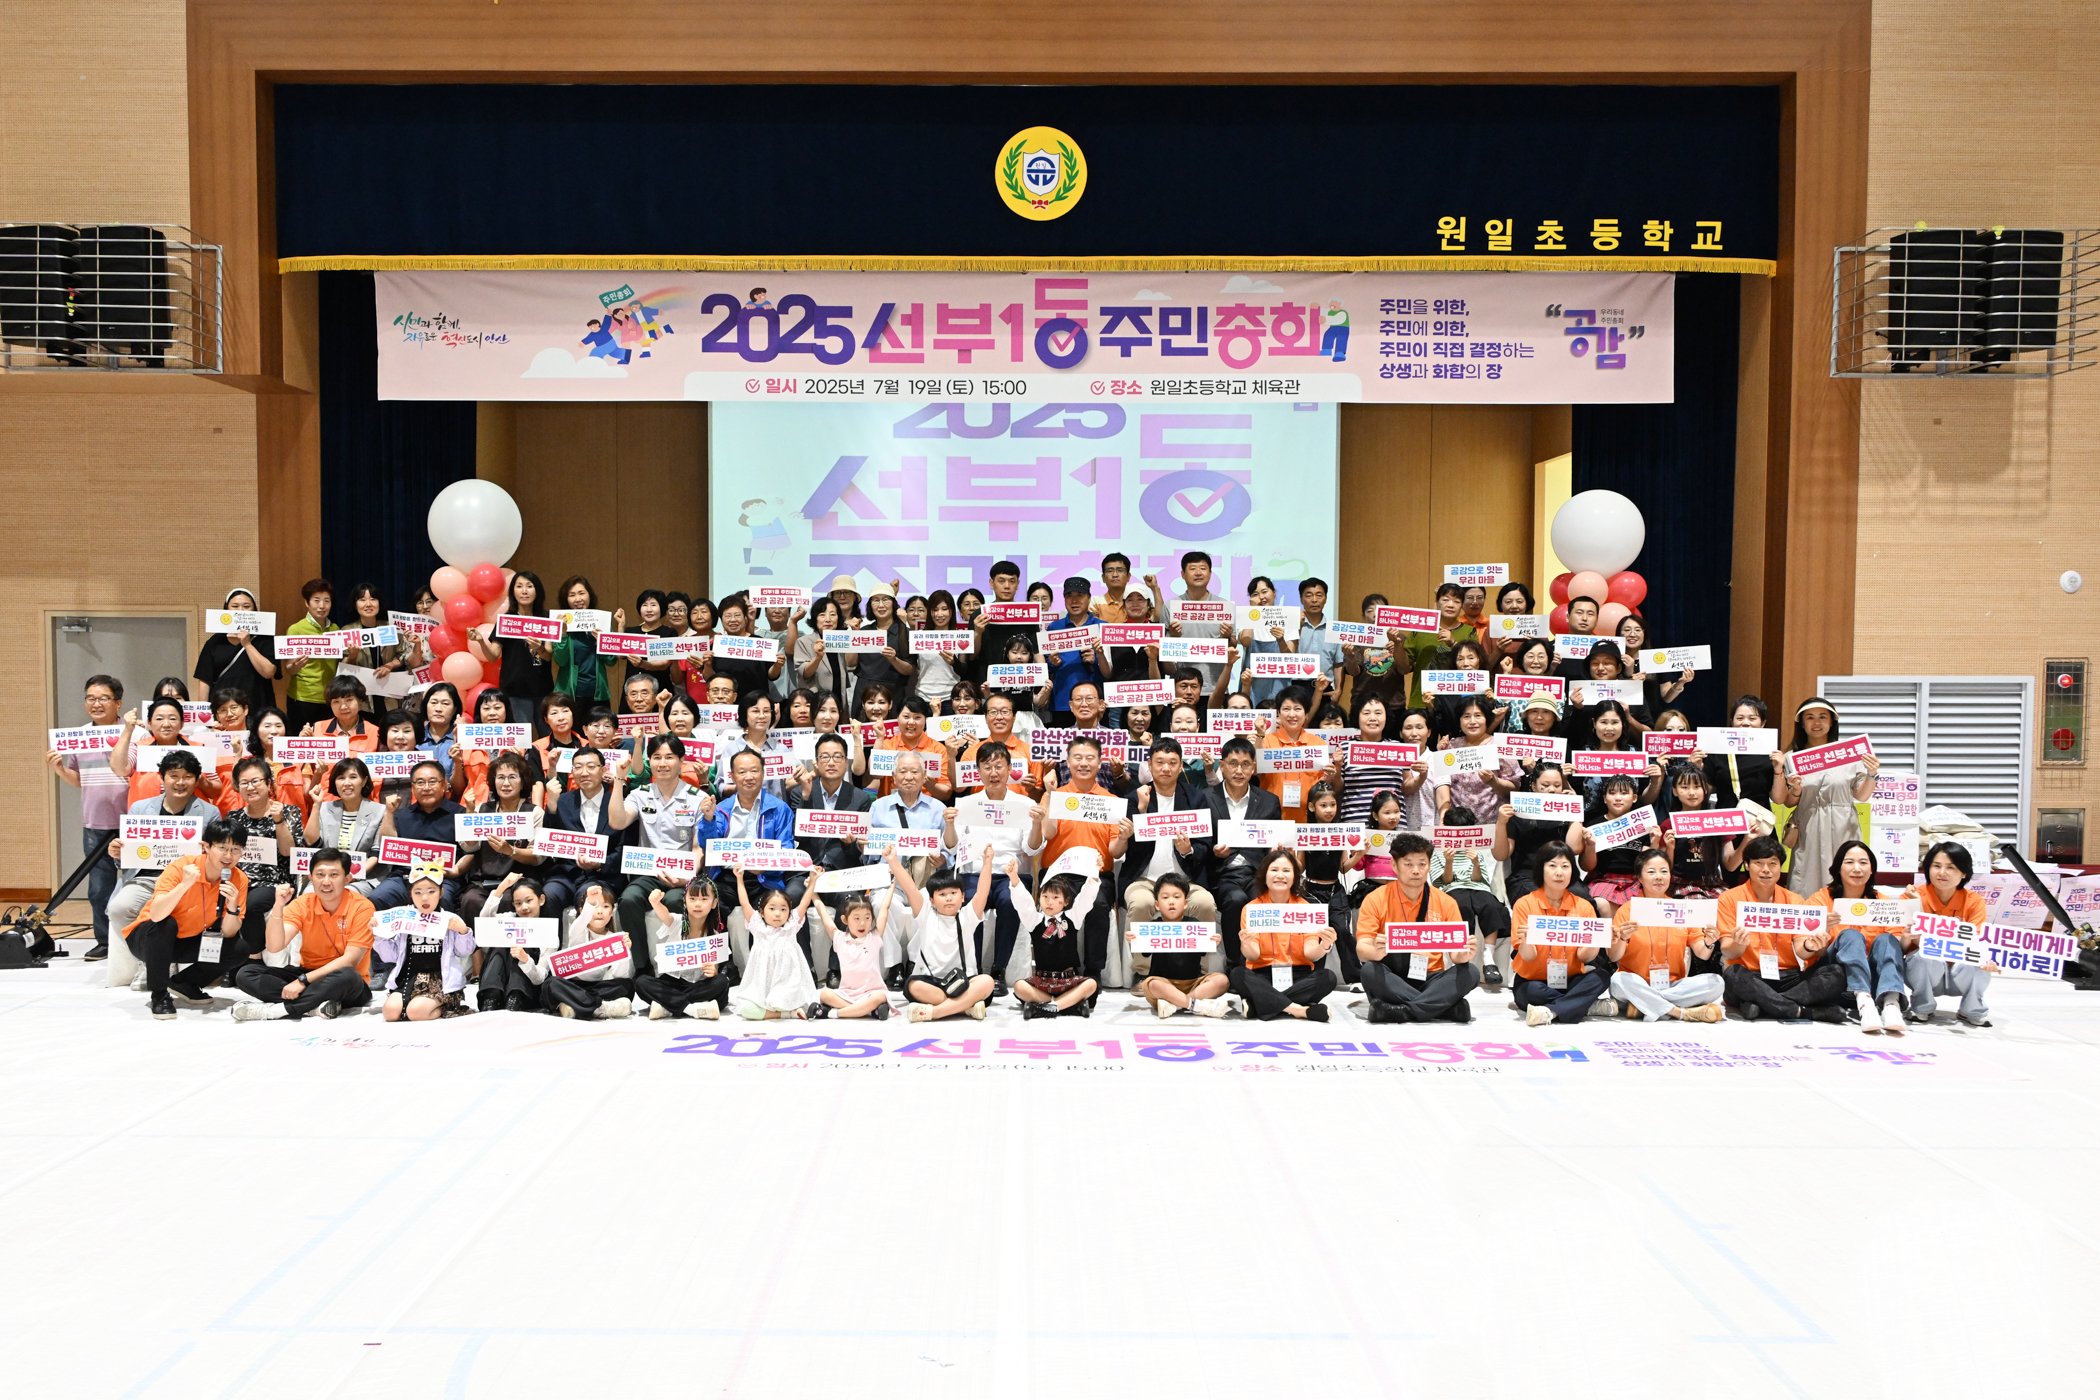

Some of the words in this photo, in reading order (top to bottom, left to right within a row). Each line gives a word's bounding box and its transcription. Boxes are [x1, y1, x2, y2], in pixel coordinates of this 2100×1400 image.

[603, 289, 632, 304] 주민총회
[1380, 298, 1428, 314] 주민을
[1432, 298, 1470, 316] 위한,
[701, 292, 857, 366] 2025
[862, 277, 1089, 370] 선부1동
[1099, 303, 1321, 370] 주민총회
[1380, 320, 1428, 337] 주민에
[1432, 320, 1470, 339] 의한,
[441, 331, 482, 349] 혁신도시
[485, 332, 510, 344] 안산
[1380, 341, 1428, 357] 주민이
[1432, 341, 1465, 357] 직접
[1470, 341, 1534, 357] 결정하는
[1380, 363, 1428, 379] 상생과
[1432, 363, 1482, 380] 화합의
[1486, 363, 1501, 380] 장
[766, 378, 797, 393] 일시
[805, 379, 864, 395] 2025년
[874, 379, 900, 395] 7월
[908, 379, 942, 395] 19일
[947, 378, 974, 397] (토)
[983, 380, 1027, 395] 15:00
[1110, 379, 1142, 396] 장소
[1151, 379, 1247, 397] 원일초등학교
[1251, 378, 1300, 397] 체육관
[802, 413, 1252, 542] 선부1동
[1451, 566, 1483, 575] 공감으로
[1487, 566, 1502, 574] 잇는
[1459, 576, 1475, 584] 우리
[1478, 575, 1495, 584] 마을
[1006, 607, 1037, 619] 선부1동
[1400, 614, 1436, 626] 선부1동
[523, 623, 558, 636] 선부1동
[1126, 629, 1162, 640] 선부1동
[1332, 623, 1364, 632] 공감으로
[1367, 626, 1383, 635] 잇는
[378, 627, 396, 645] 길
[852, 637, 885, 646] 선부1동
[1339, 634, 1355, 642] 우리
[1358, 635, 1374, 644] 마을
[675, 641, 708, 652] 선부1동
[720, 637, 753, 647] 공감으로
[757, 640, 772, 649] 잇는
[915, 640, 956, 651] 선부1동!
[728, 647, 743, 656] 우리
[747, 649, 763, 658] 마을
[1190, 644, 1225, 655] 선부1동
[1027, 666, 1042, 674] 잇는
[1256, 664, 1301, 674] 선부1동!
[1019, 676, 1034, 684] 마을
[1428, 673, 1464, 681] 공감으로
[1467, 673, 1484, 681] 잇는
[1437, 683, 1455, 691] 우리
[1458, 683, 1475, 691] 마을
[465, 726, 502, 735] 공감으로
[506, 726, 525, 735] 잇는
[56, 738, 105, 750] 선부1동!
[475, 737, 493, 747] 우리
[496, 737, 515, 747] 마을
[328, 751, 346, 759] 변화
[1032, 746, 1061, 759] 안산
[1264, 750, 1301, 760] 공감으로
[1305, 749, 1323, 758] 잇는
[1377, 750, 1416, 761] 선부1동
[1515, 748, 1533, 757] 공감
[1824, 744, 1868, 762] 선부1동
[364, 755, 404, 764] 공감으로
[407, 754, 427, 763] 잇는
[1273, 760, 1293, 769] 우리
[1295, 760, 1314, 769] 마을
[1603, 759, 1644, 771] 선부1동
[375, 766, 394, 775] 우리
[1873, 792, 1917, 801] 주민총회
[1543, 801, 1581, 813] 선부1동
[1871, 804, 1896, 815] 사전투표
[463, 815, 503, 826] 공감으로
[506, 815, 526, 825] 잇는
[1703, 815, 1745, 828] 선부1동
[127, 827, 179, 839] 선부1동!
[474, 827, 493, 837] 우리
[497, 827, 516, 837] 마을
[819, 824, 836, 833] 공감
[1138, 828, 1156, 837] 작은
[1158, 827, 1176, 835] 공감
[713, 841, 751, 850] 공감으로
[898, 836, 938, 848] 선부1동
[1297, 835, 1345, 847] 선부1동!
[537, 843, 556, 852] 작은
[558, 845, 576, 855] 공감
[656, 857, 694, 870] 선부1동
[1283, 912, 1326, 924] 선부1동
[1744, 916, 1801, 930] 선부1동!
[1139, 925, 1182, 936] 공감으로
[1186, 925, 1207, 935] 잇는
[1536, 918, 1579, 930] 공감으로
[1583, 920, 1604, 931] 잇는
[1392, 928, 1417, 936] 공감으로
[1420, 930, 1464, 944] 선부1동
[1546, 932, 1568, 942] 우리
[1571, 933, 1592, 944] 마을
[1915, 915, 1973, 940] 지상은
[1979, 926, 2073, 957] 시민에게!
[412, 944, 440, 953] HEART
[1150, 938, 1171, 949] 우리
[1176, 938, 1197, 948] 마을
[582, 941, 625, 964] 선부1동
[1923, 938, 1980, 962] 철도는
[1988, 948, 2059, 976] 지하로!
[662, 1034, 883, 1058] 2025
[891, 1033, 1215, 1062] 선부1동
[1226, 1041, 1546, 1063] 주민총회
